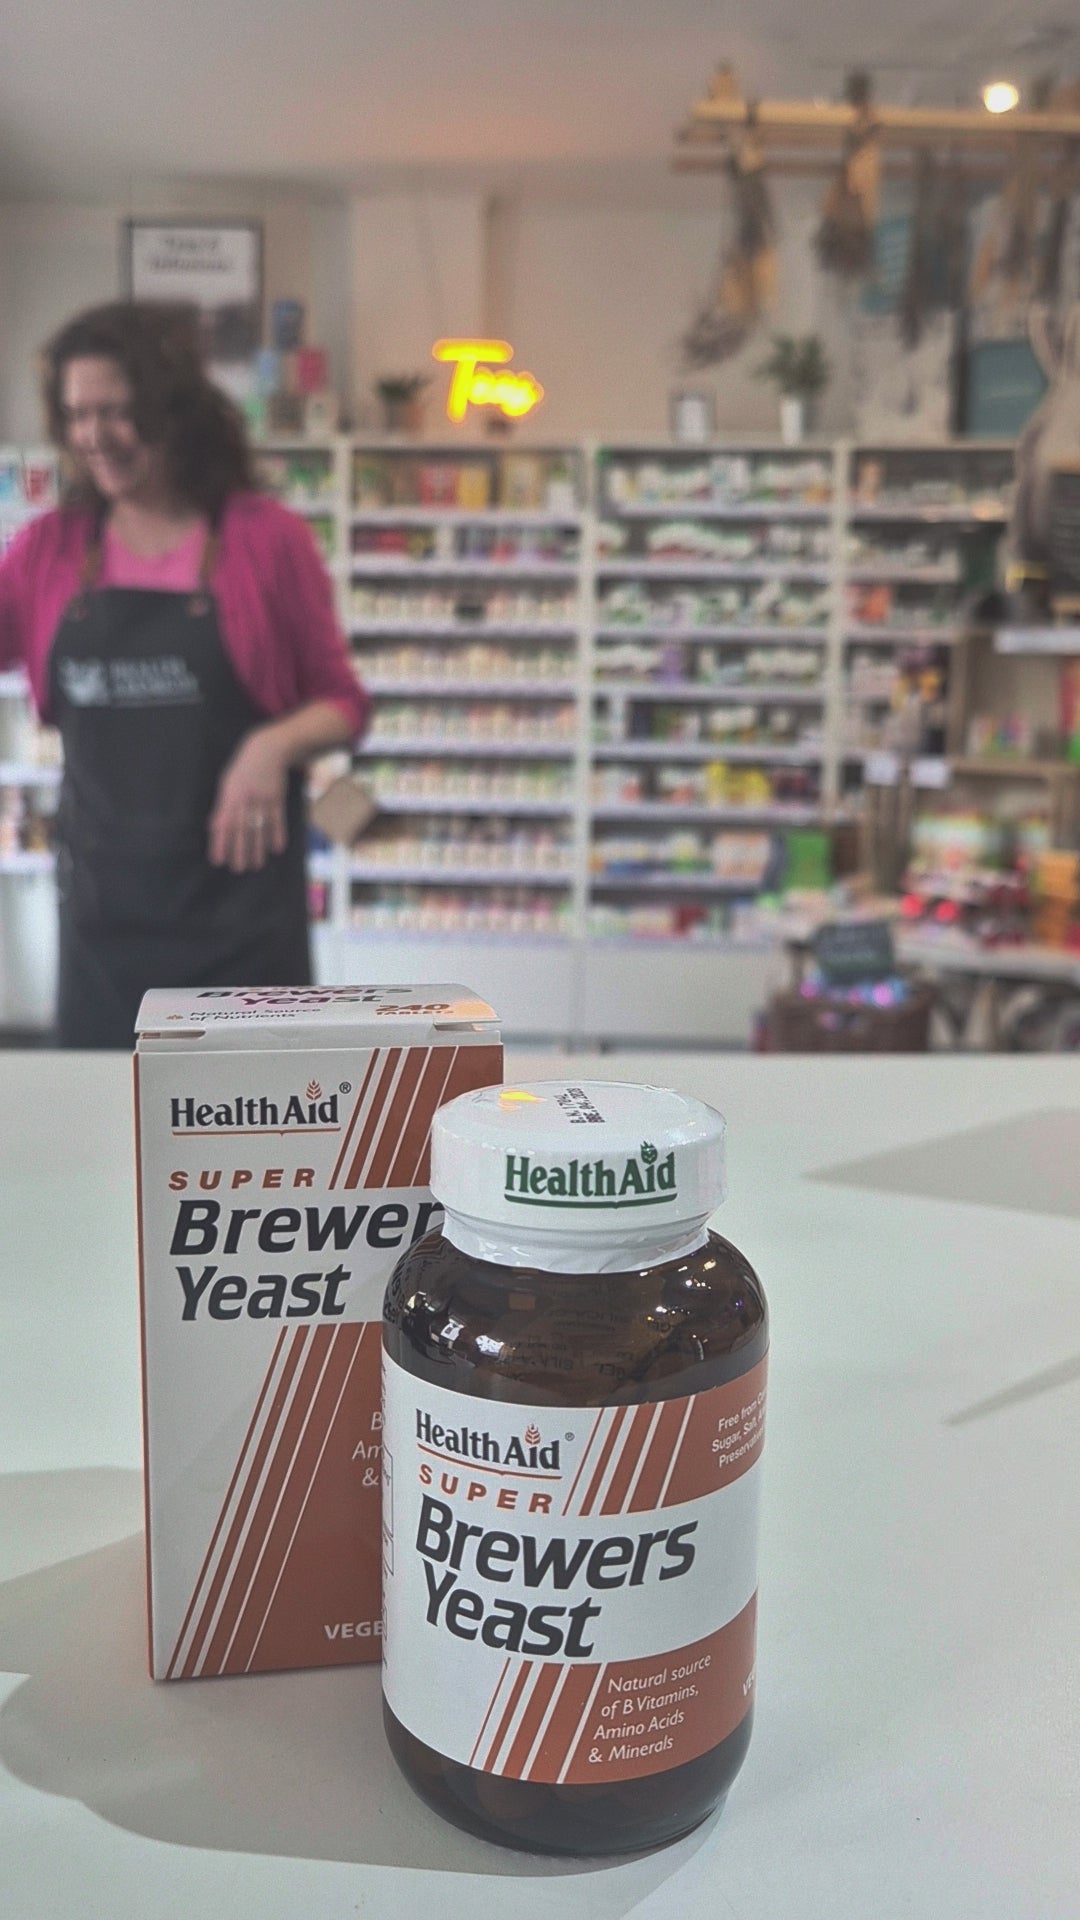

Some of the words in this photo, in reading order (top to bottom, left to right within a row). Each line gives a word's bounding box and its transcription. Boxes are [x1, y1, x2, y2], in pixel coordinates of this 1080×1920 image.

[196, 989, 412, 999] Brewers
[241, 995, 384, 1005] Yeast
[376, 1004, 450, 1012] 240
[168, 1168, 315, 1191] SUPER
[504, 1152, 676, 1197] HealthAid
[169, 1200, 444, 1256] Brewer
[175, 1263, 352, 1321] Yeast
[718, 1413, 740, 1432] Free
[362, 1467, 379, 1486] &
[419, 1463, 553, 1514] SUPER
[415, 1493, 698, 1590] Brewers
[421, 1558, 602, 1658] Yeast
[607, 1668, 667, 1693] Natural
[671, 1654, 711, 1681] source
[601, 1701, 620, 1720] of
[622, 1700, 634, 1715] B
[637, 1684, 699, 1712] Vitamins,
[593, 1723, 645, 1741] Amino
[647, 1709, 685, 1733] Acids
[588, 1747, 603, 1763] &
[608, 1735, 674, 1762] Minerals
